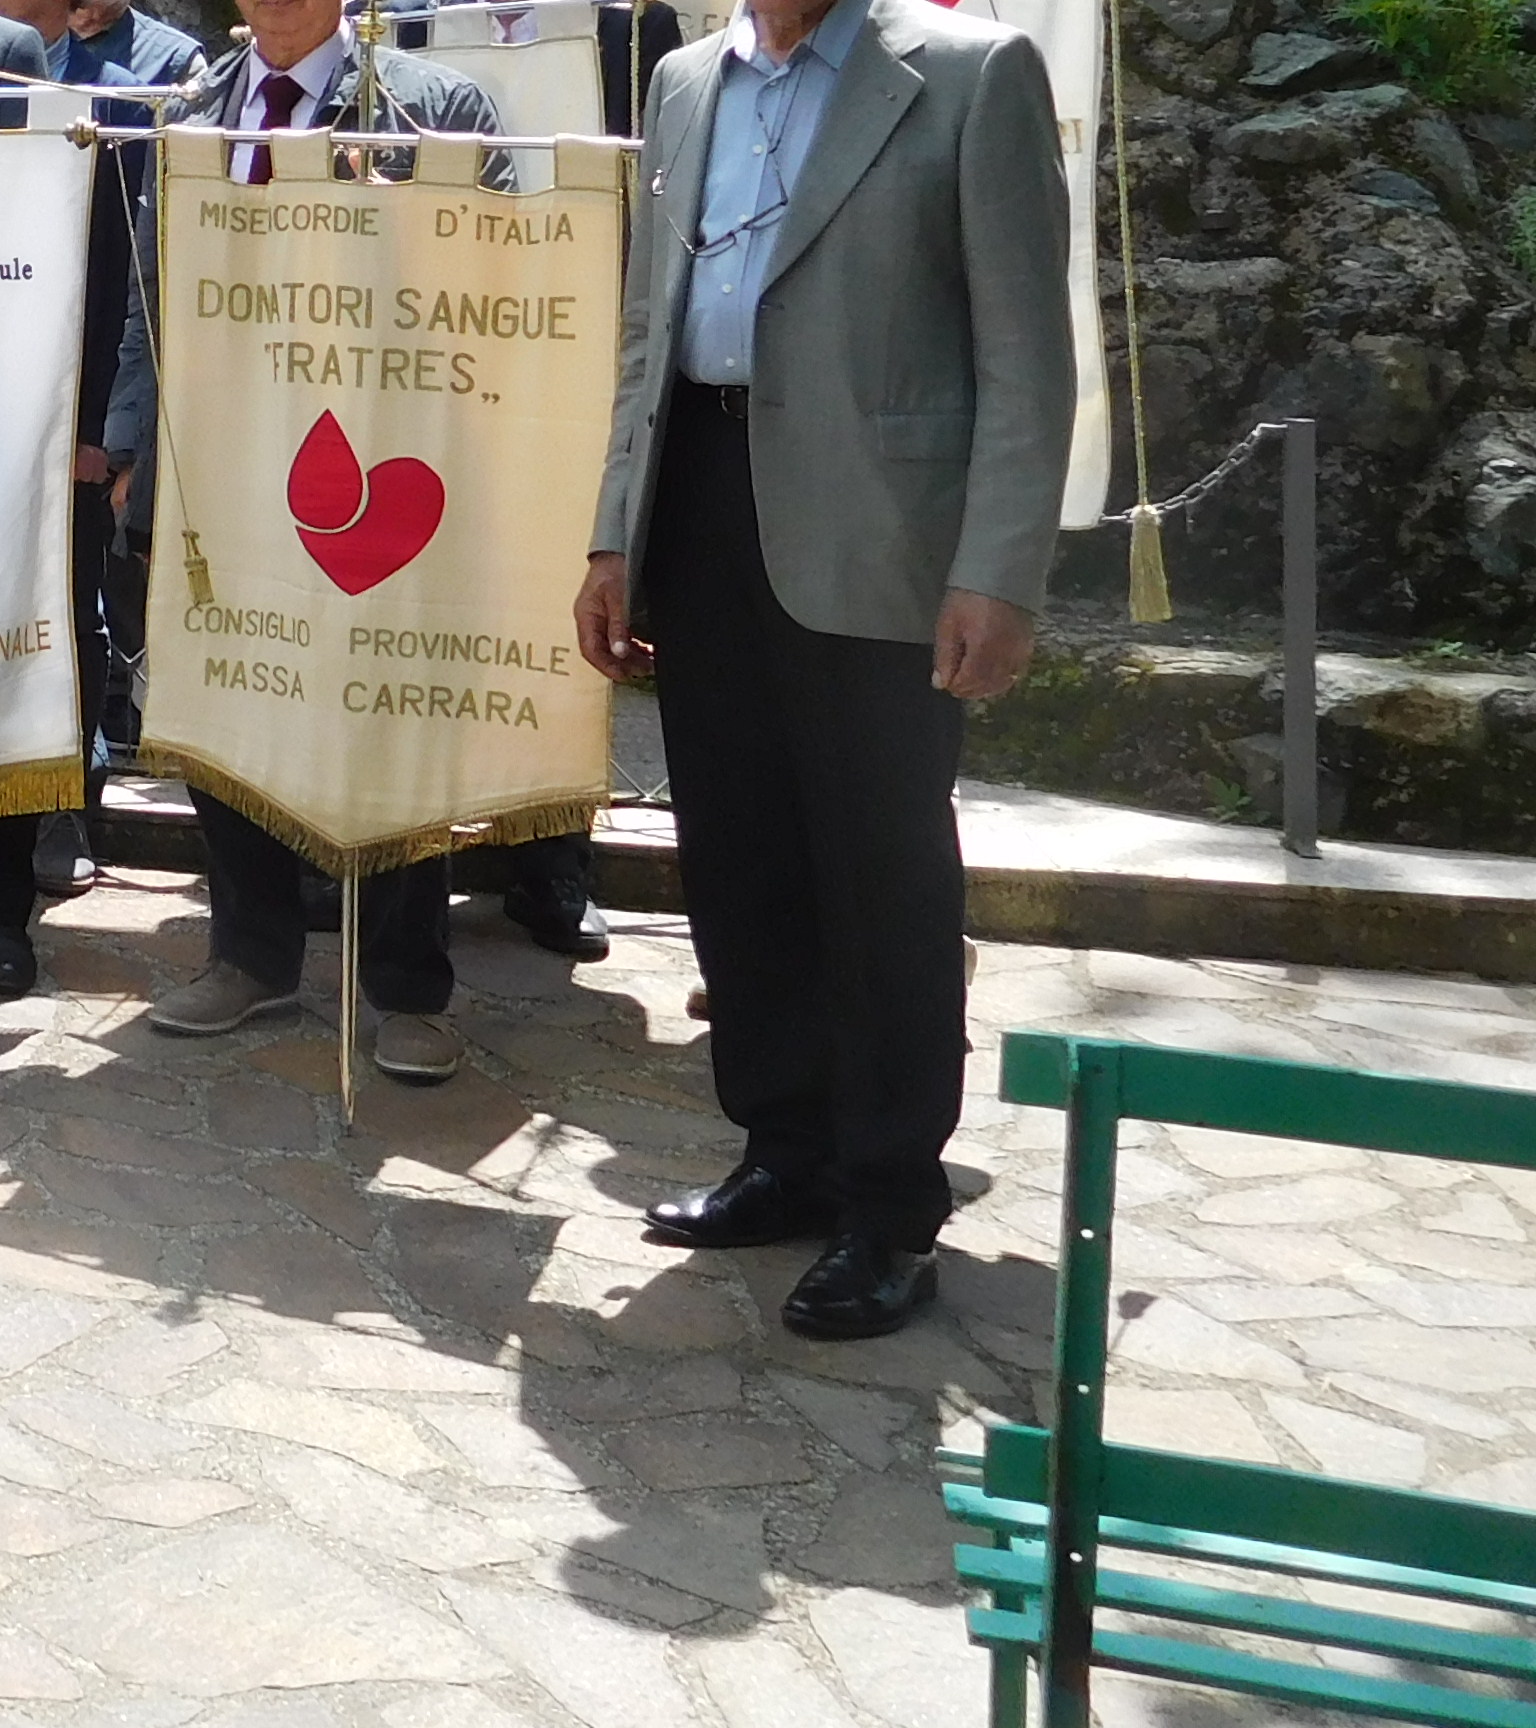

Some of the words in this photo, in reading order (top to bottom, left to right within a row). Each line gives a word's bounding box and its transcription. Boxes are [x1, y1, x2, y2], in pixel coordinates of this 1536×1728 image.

[393, 287, 576, 341] SANGUE
[184, 604, 311, 648] CONSIGLIO
[349, 627, 571, 677] PROVINCIALE
[204, 657, 305, 702] MASSA
[343, 681, 539, 730] CARRARA
